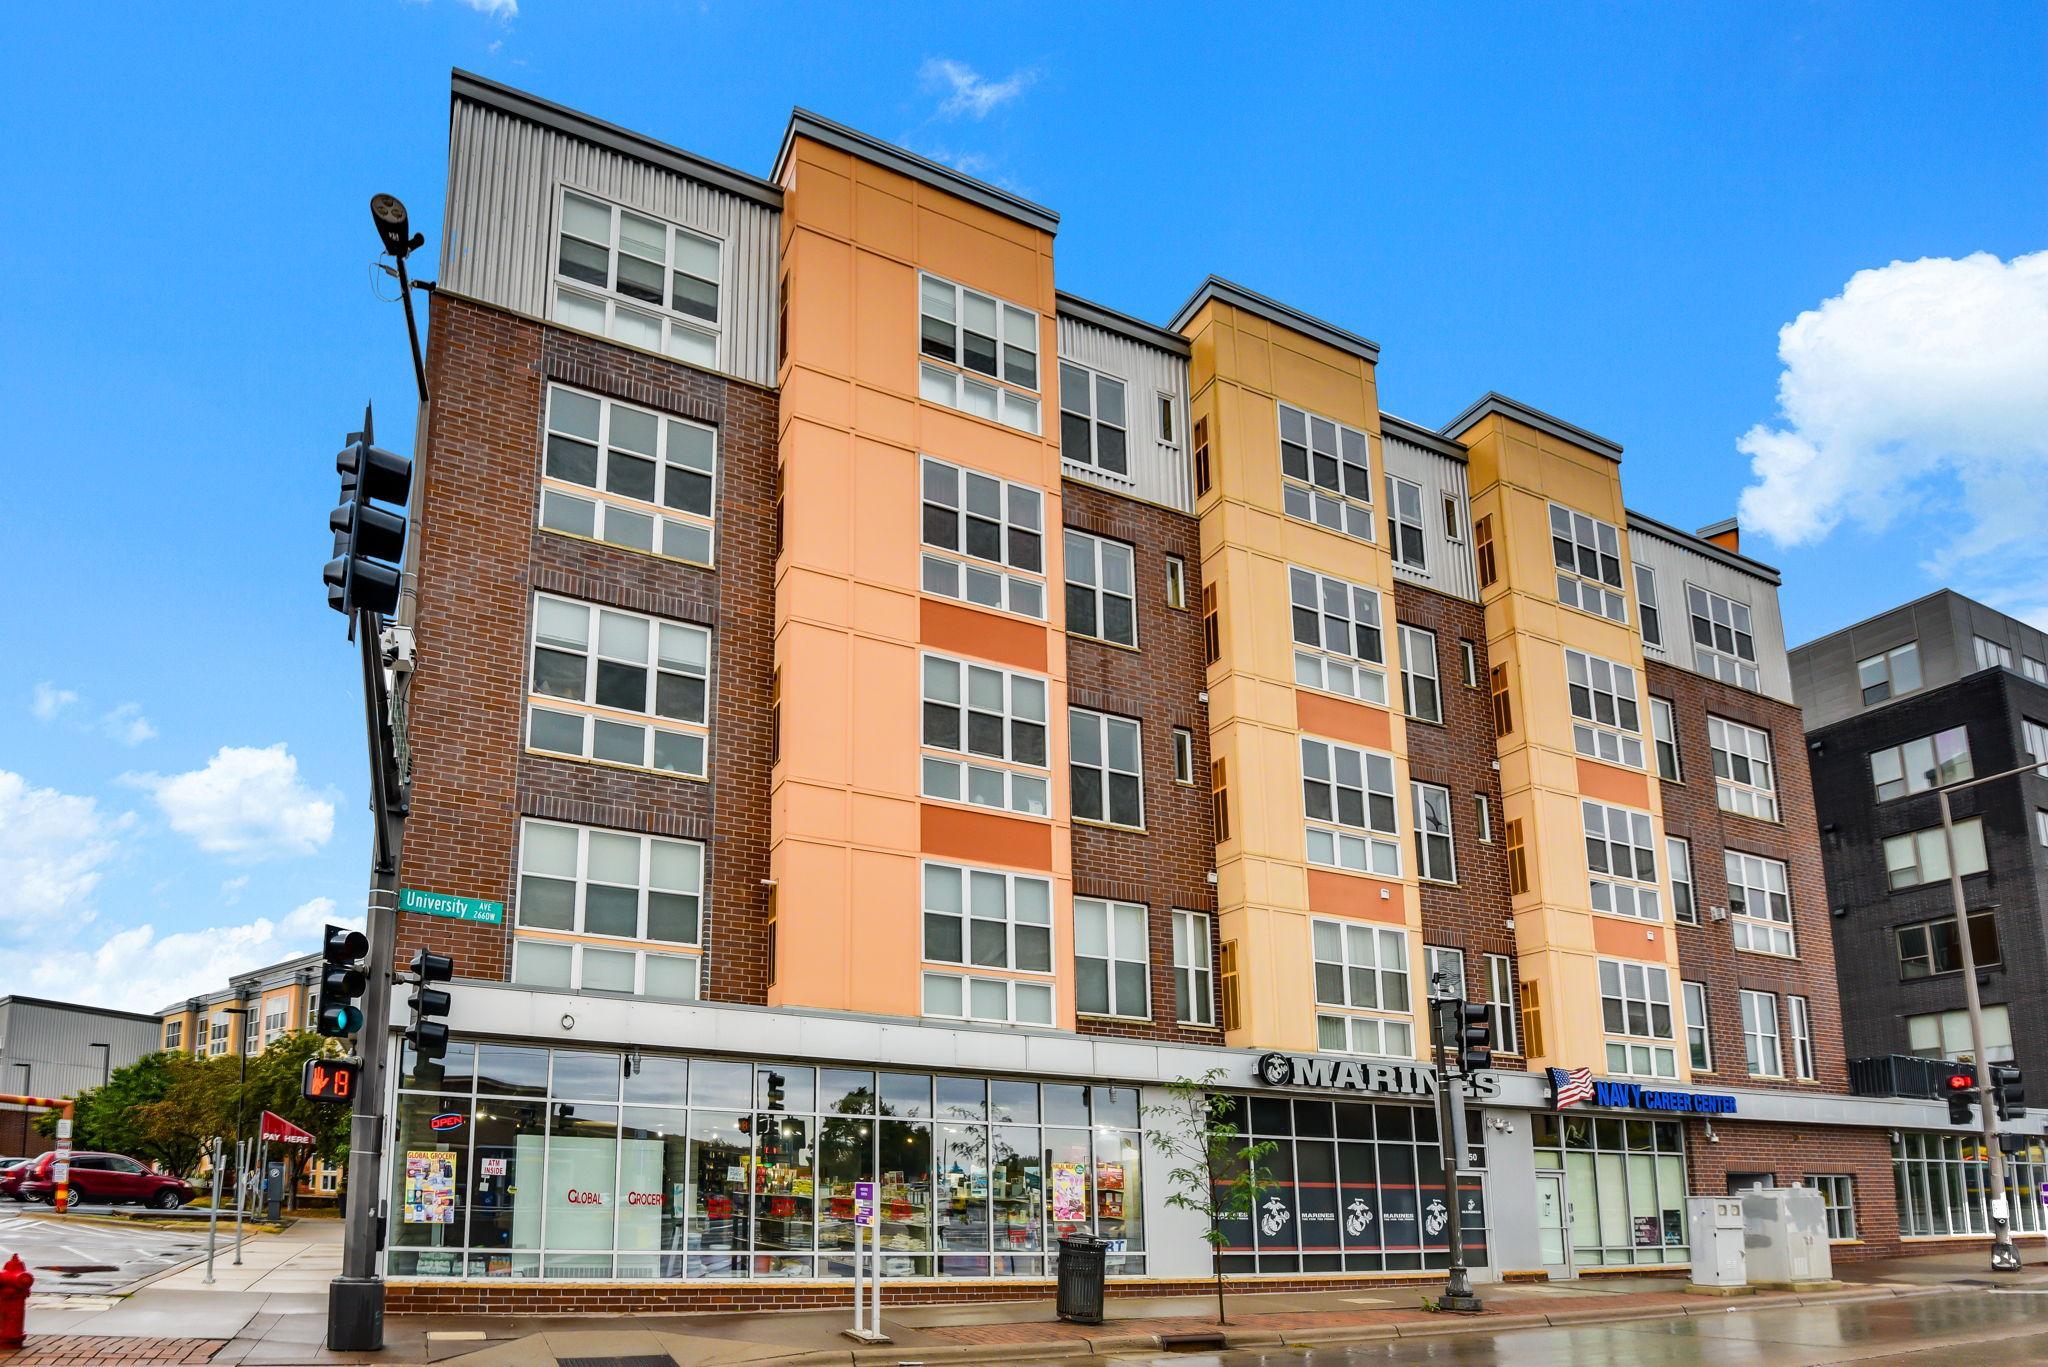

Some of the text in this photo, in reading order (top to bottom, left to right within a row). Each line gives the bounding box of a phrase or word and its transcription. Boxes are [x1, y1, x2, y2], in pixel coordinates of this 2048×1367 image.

[406, 891, 468, 918] University
[479, 903, 492, 912] AVE
[473, 910, 496, 921] 2660W
[1597, 1081, 1738, 1114] NAVY CAREER CENTER
[431, 1115, 463, 1129] OPEN
[262, 1132, 310, 1144] PAY HERE
[407, 1152, 456, 1160] GLOBAL GROCERY
[484, 1167, 503, 1175] INSIDE
